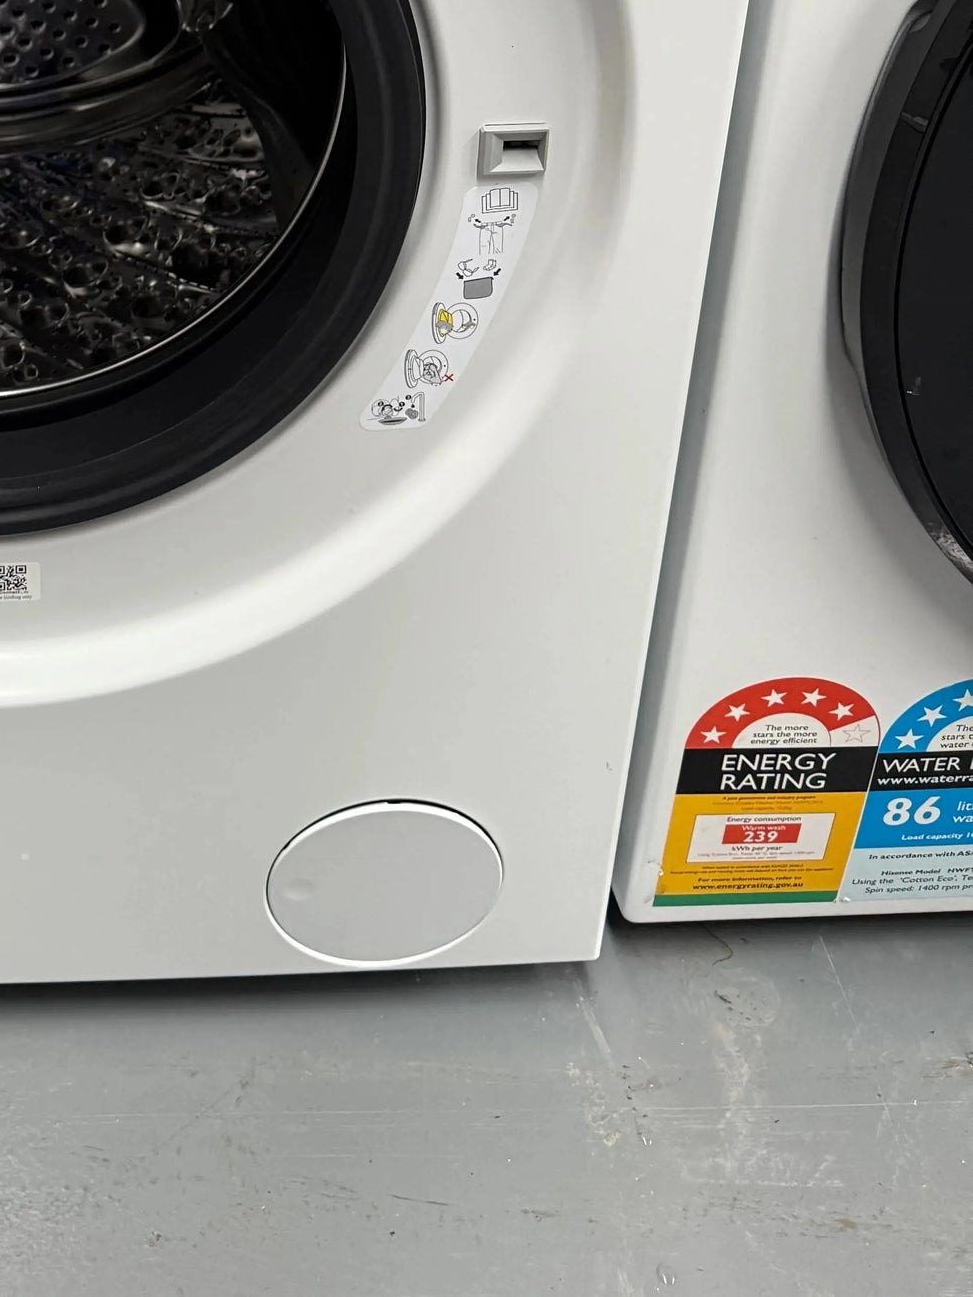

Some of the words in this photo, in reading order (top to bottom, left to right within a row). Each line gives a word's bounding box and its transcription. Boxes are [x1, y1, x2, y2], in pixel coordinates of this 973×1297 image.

[765, 724, 782, 732] The
[750, 738, 781, 746] energy
[721, 753, 837, 772] ENERGY
[883, 757, 961, 773] WATER
[720, 773, 827, 791] RATING
[883, 796, 941, 826] 86
[727, 816, 752, 824] Energy
[743, 831, 779, 843] 239
[925, 833, 964, 841] capacity
[766, 845, 783, 853] year
[865, 886, 884, 894] Spin
